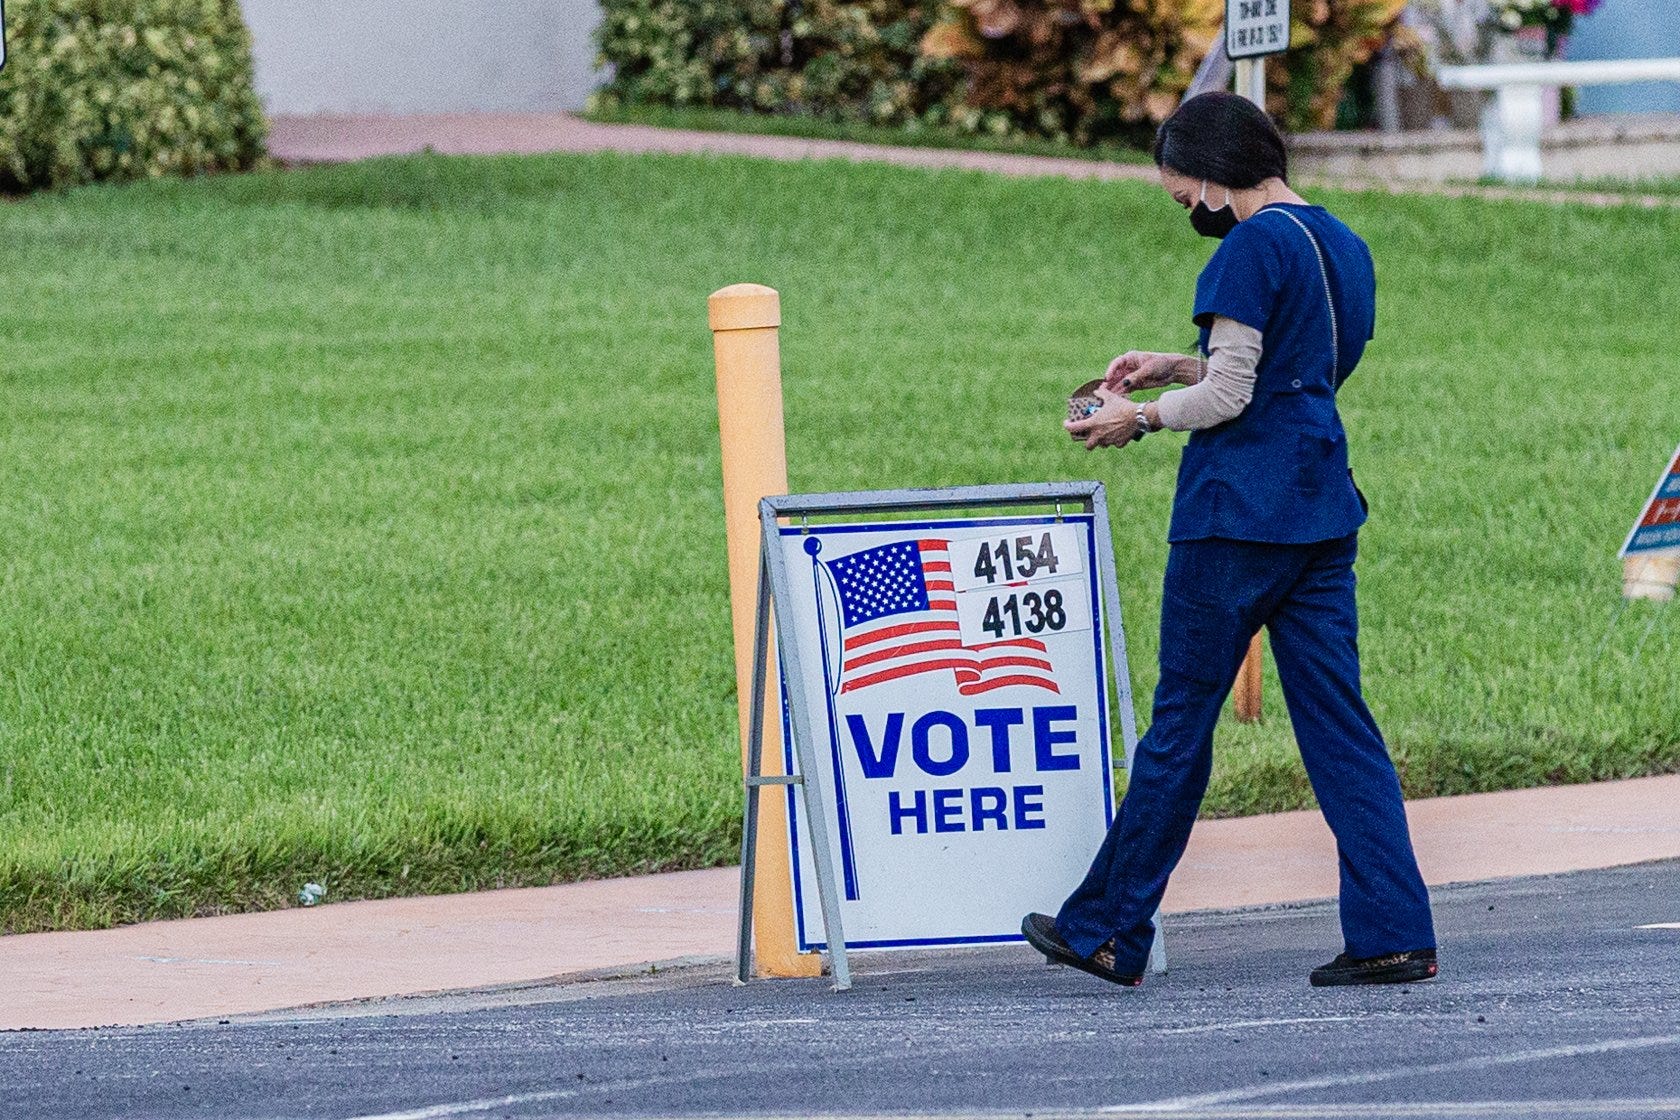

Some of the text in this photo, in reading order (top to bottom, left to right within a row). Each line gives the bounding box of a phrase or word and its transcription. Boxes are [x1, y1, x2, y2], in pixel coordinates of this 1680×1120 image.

[974, 532, 1059, 583] 4154
[982, 588, 1067, 638] 4138
[846, 705, 1081, 779] VOTE
[890, 785, 1046, 835] HERE
